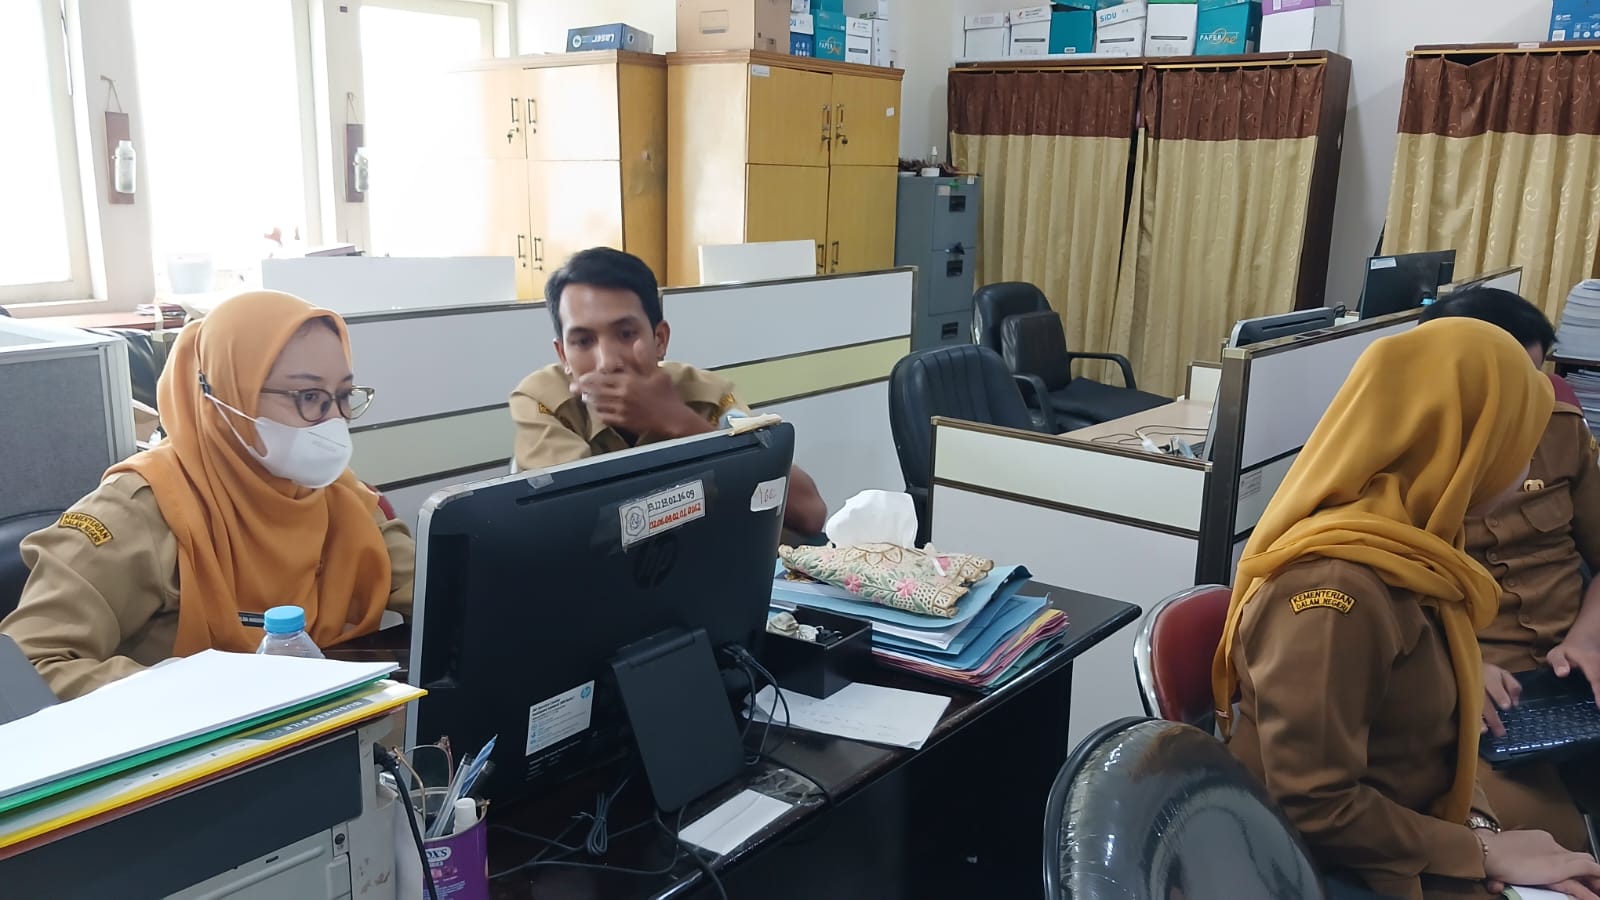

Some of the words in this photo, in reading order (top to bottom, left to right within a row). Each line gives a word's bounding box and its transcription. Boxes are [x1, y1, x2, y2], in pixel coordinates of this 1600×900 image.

[64, 514, 111, 539] KEMENTERIAN
[1293, 590, 1353, 606] KEMENTERIAN
[1296, 599, 1320, 610] DALAM
[1323, 599, 1349, 612] NEGERI
